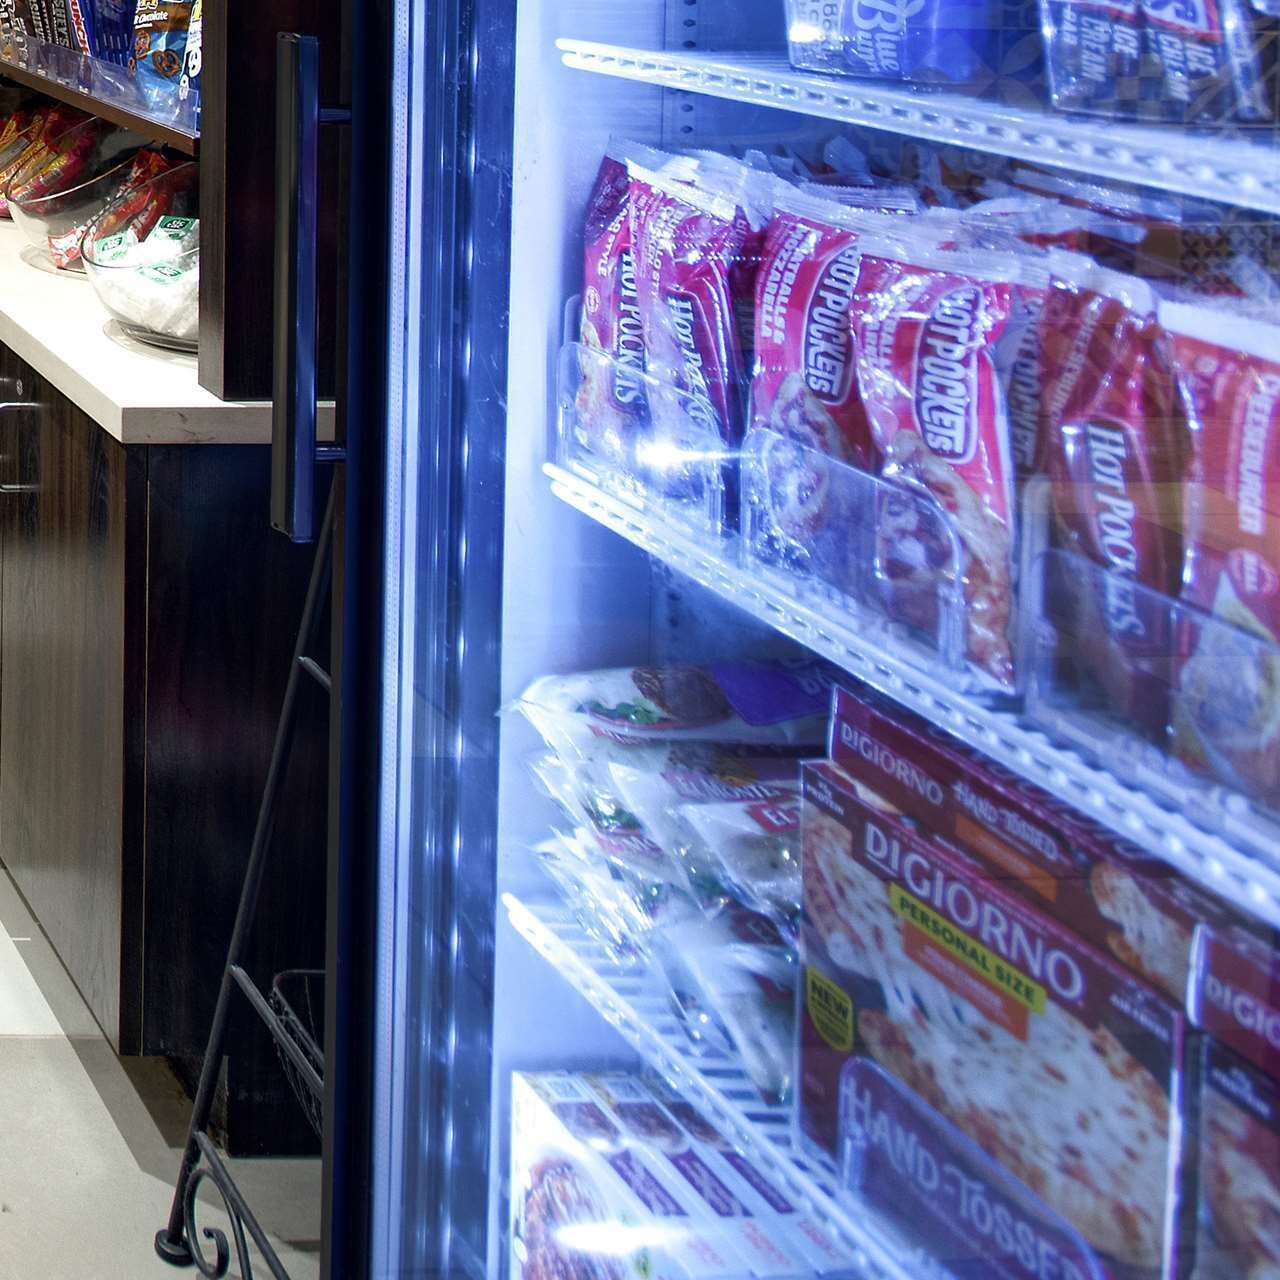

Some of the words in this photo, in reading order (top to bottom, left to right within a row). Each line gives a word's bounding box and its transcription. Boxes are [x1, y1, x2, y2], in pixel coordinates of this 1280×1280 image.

[1081, 17, 1110, 83] CREAM
[1113, 23, 1139, 59] ICE
[1185, 41, 1218, 78] ICE
[803, 290, 850, 402] POCKETS
[932, 292, 978, 346] HOT
[921, 342, 972, 454] POCKETS
[1086, 424, 1129, 492] HOT
[1094, 491, 1146, 637] POCKETS
[840, 720, 944, 807] DIGIORNO
[864, 820, 1085, 1002] DIGIORNO
[898, 894, 992, 972] PERSONAL
[994, 968, 1036, 1008] SIZE
[810, 976, 851, 1019] NEW
[1205, 972, 1280, 1049] DIGIO
[843, 1075, 1083, 1280] HAND-TOSSE
